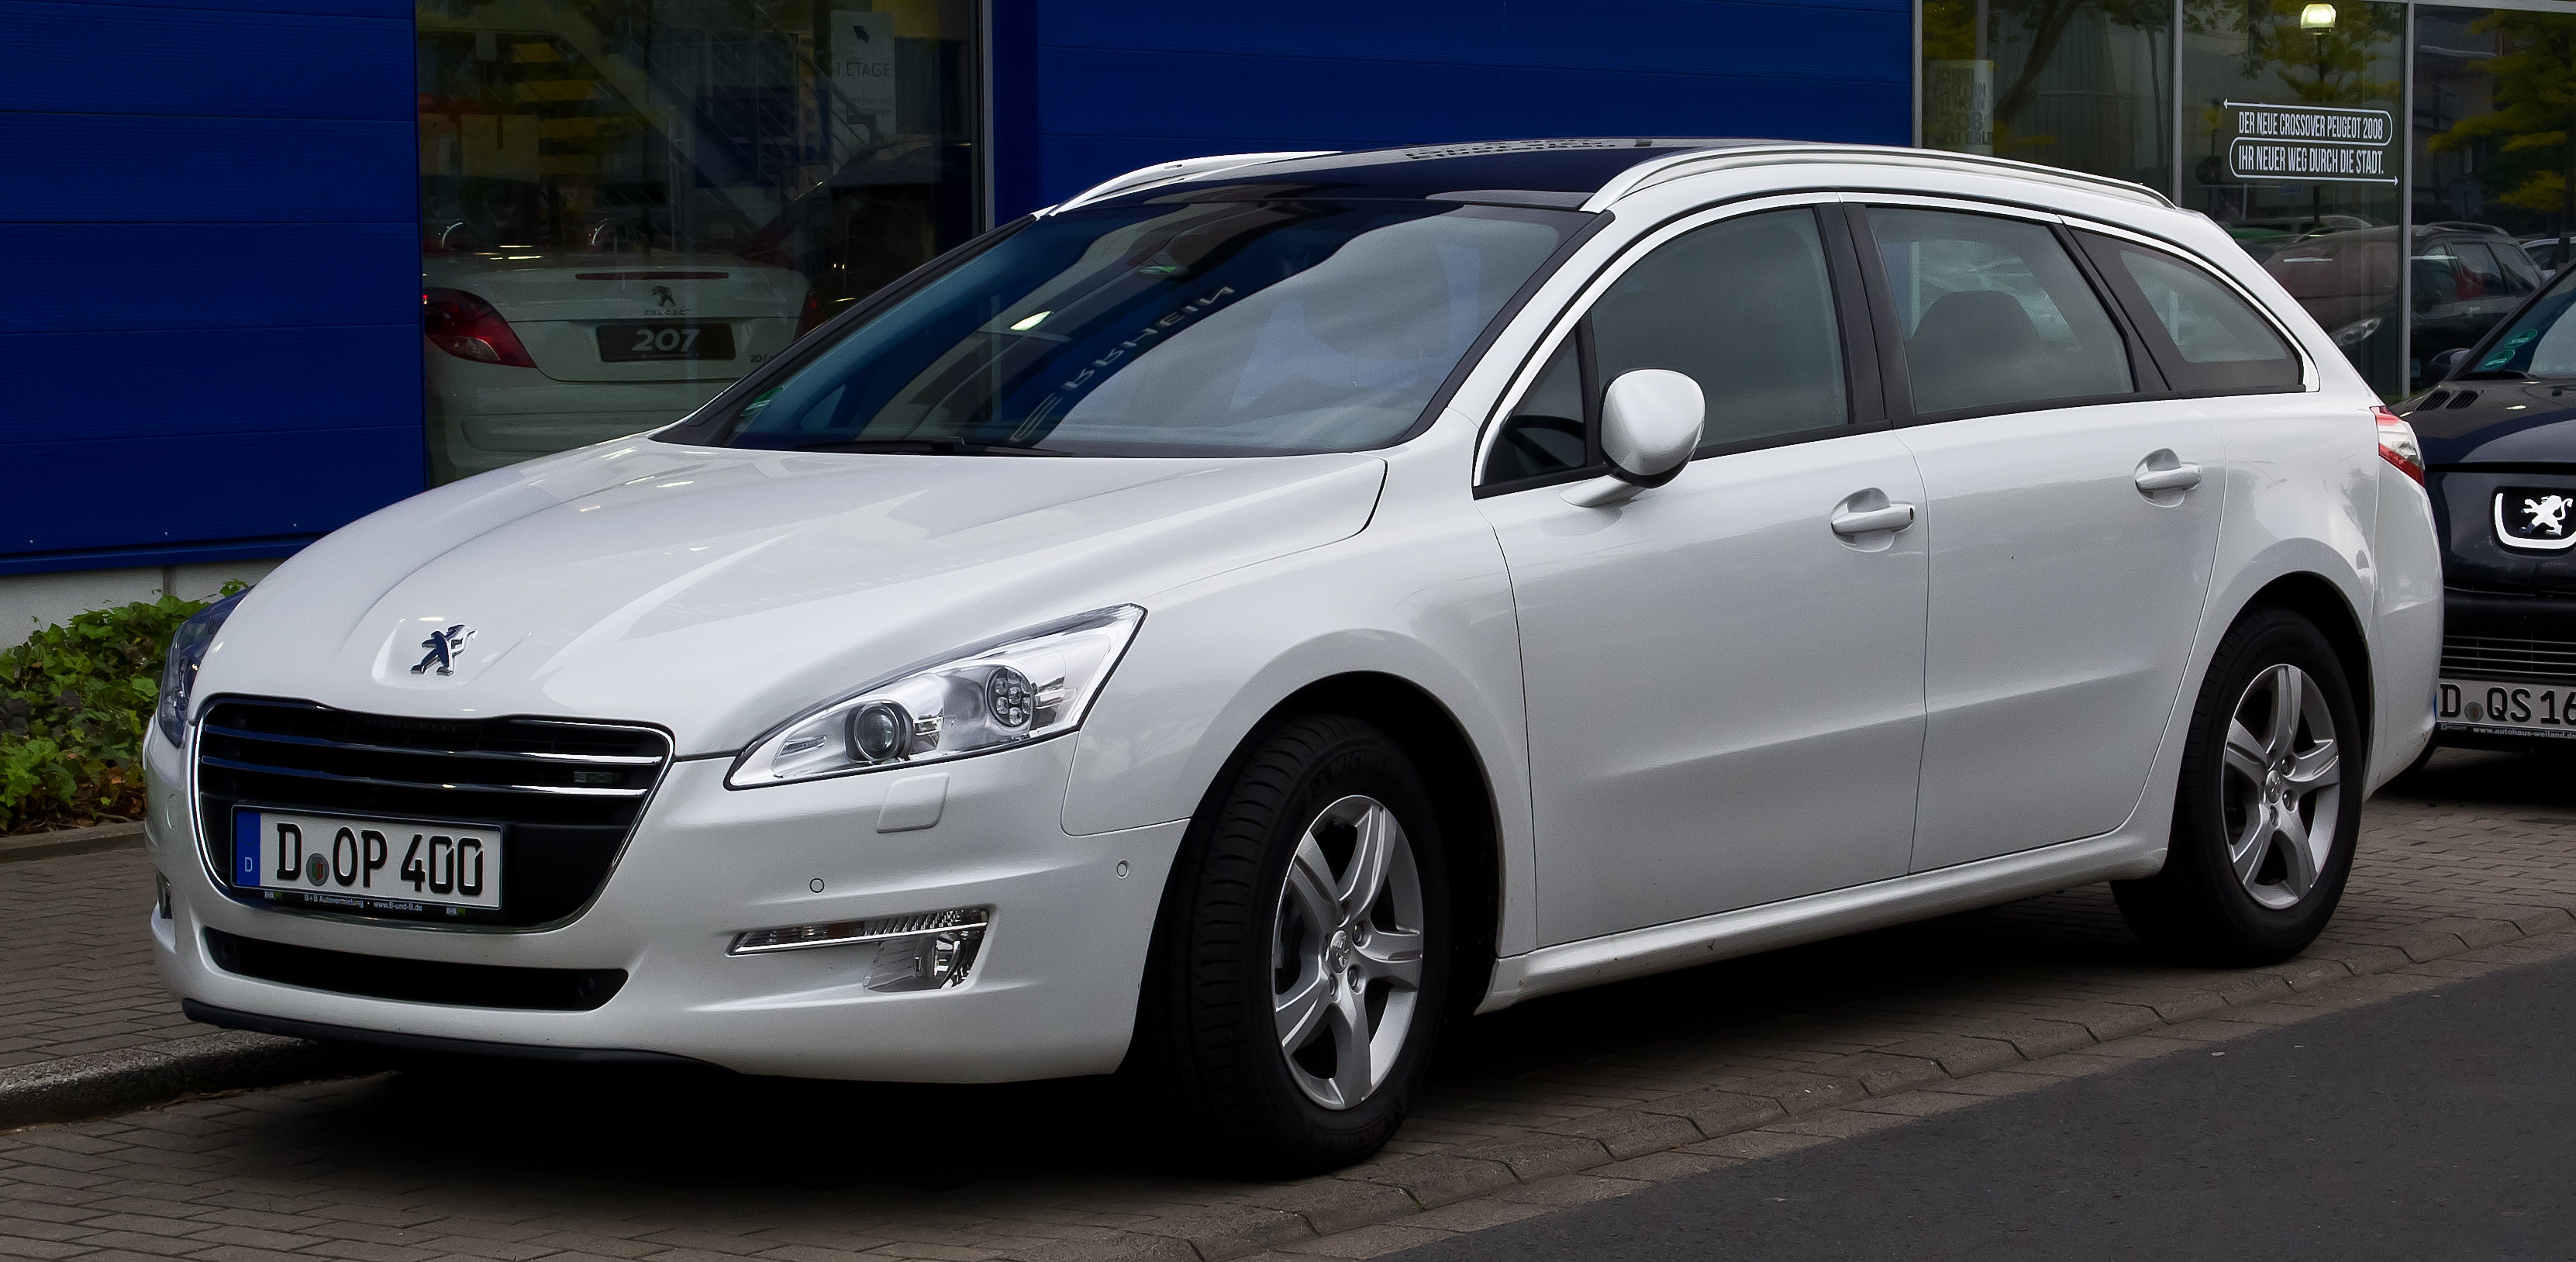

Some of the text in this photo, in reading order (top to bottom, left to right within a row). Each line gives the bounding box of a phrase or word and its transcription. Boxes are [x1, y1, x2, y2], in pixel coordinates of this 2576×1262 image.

[846, 61, 891, 77] ETAGE
[2239, 111, 2383, 140] DER NEUE CROSSOVER PEUGEOT 2008
[2239, 145, 2384, 174] IHR NEUER WEG DURCH DIE STADT.
[632, 329, 701, 352] 207
[2440, 683, 2461, 718] D
[2487, 686, 2531, 722] QS
[367, 718, 456, 732] PEUGEOT
[244, 857, 253, 872] D
[277, 822, 484, 896] D OP 400
